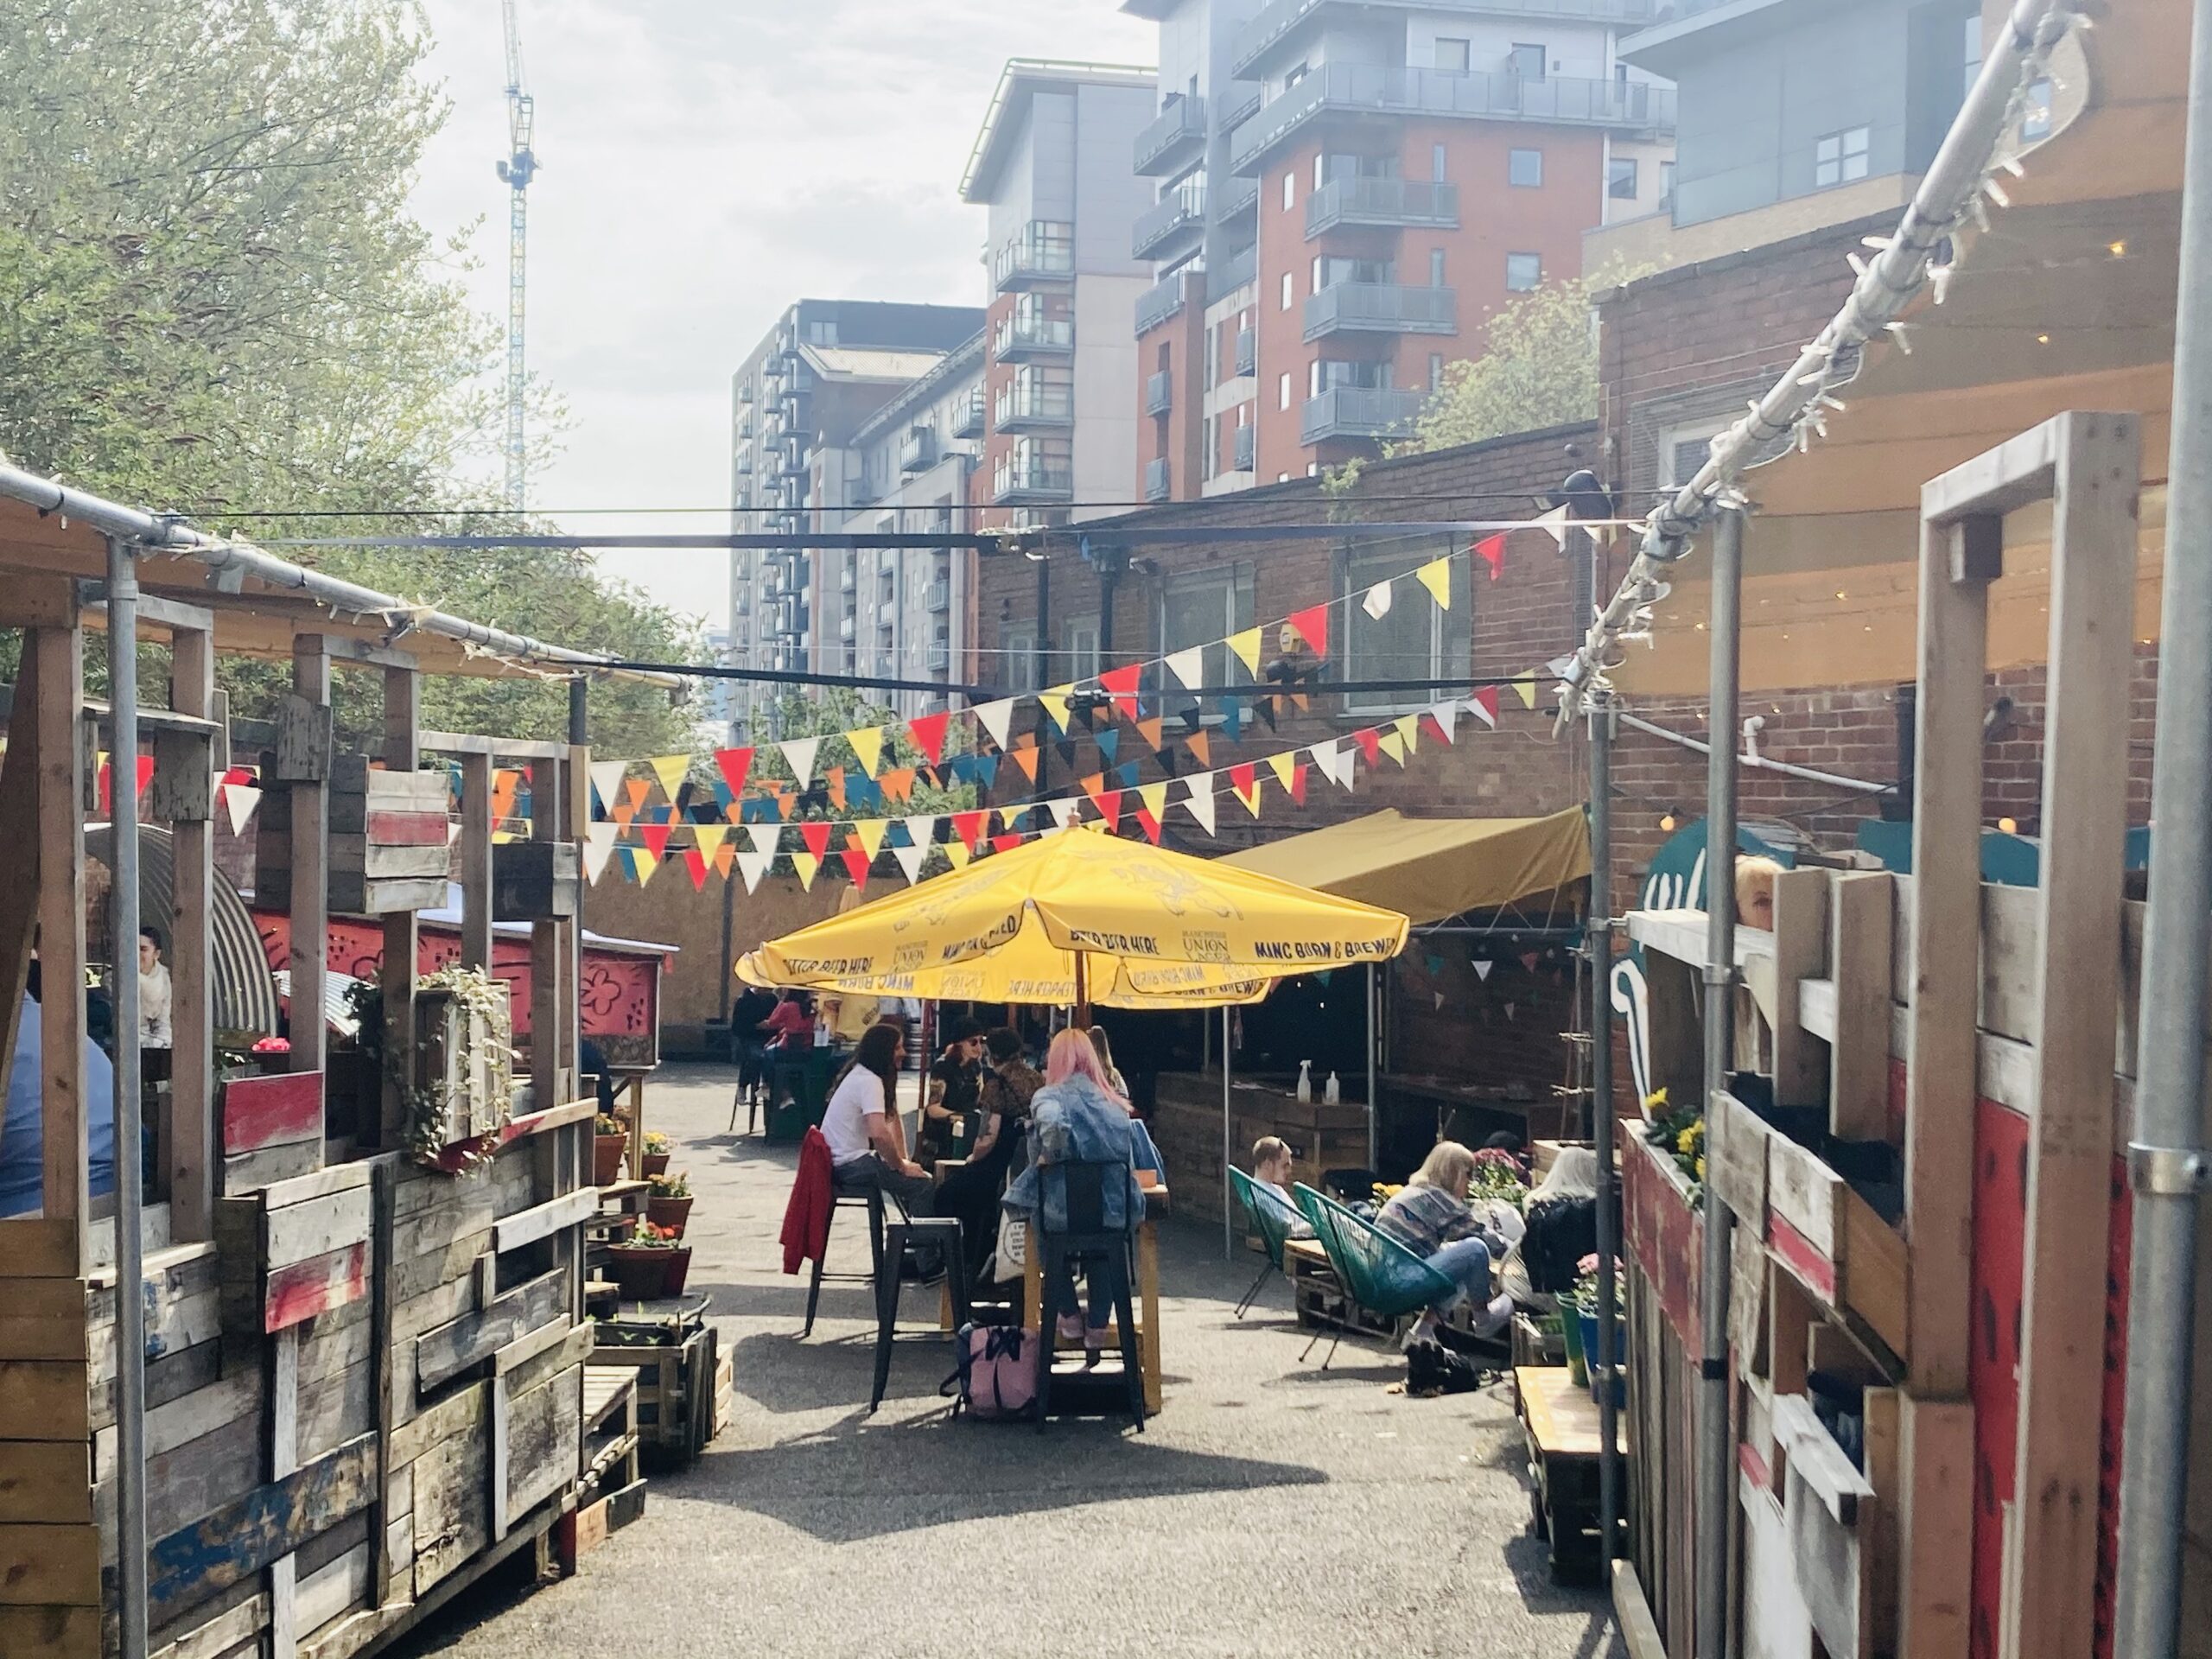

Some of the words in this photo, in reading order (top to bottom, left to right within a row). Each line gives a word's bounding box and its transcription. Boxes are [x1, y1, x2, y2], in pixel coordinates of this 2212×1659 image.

[1129, 935, 1161, 955] HERE
[1182, 938, 1229, 952] UNION
[1295, 942, 1331, 959] BORN
[1334, 941, 1342, 959] &
[848, 956, 874, 976] HERE
